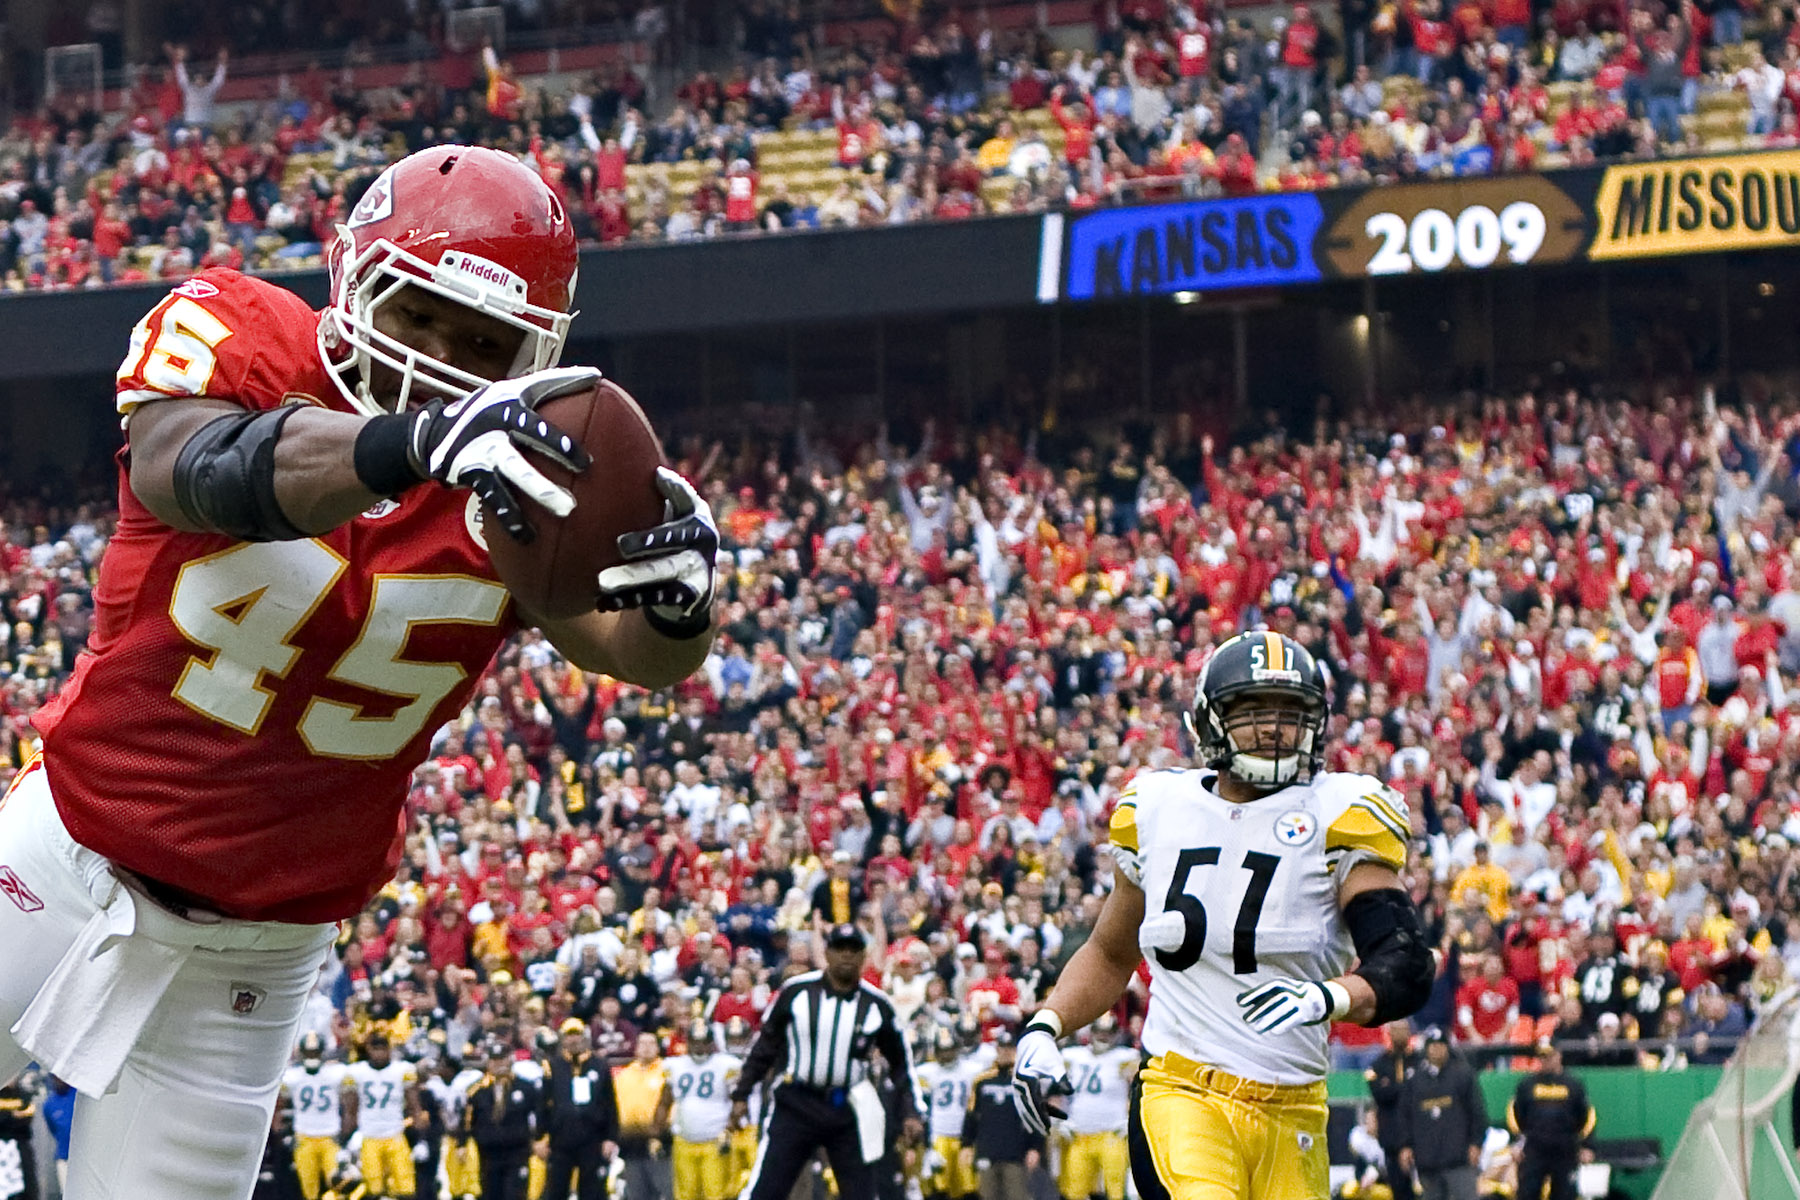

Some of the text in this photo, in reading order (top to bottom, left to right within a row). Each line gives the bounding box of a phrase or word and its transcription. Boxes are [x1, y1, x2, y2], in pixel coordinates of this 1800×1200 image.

[460, 257, 510, 287] Riddell
[1093, 207, 1298, 296] KANSAS
[1364, 200, 1547, 275] 2009
[168, 536, 511, 762] 45
[1155, 847, 1281, 976] 51
[299, 1085, 332, 1113] 95
[677, 1071, 715, 1099] 98
